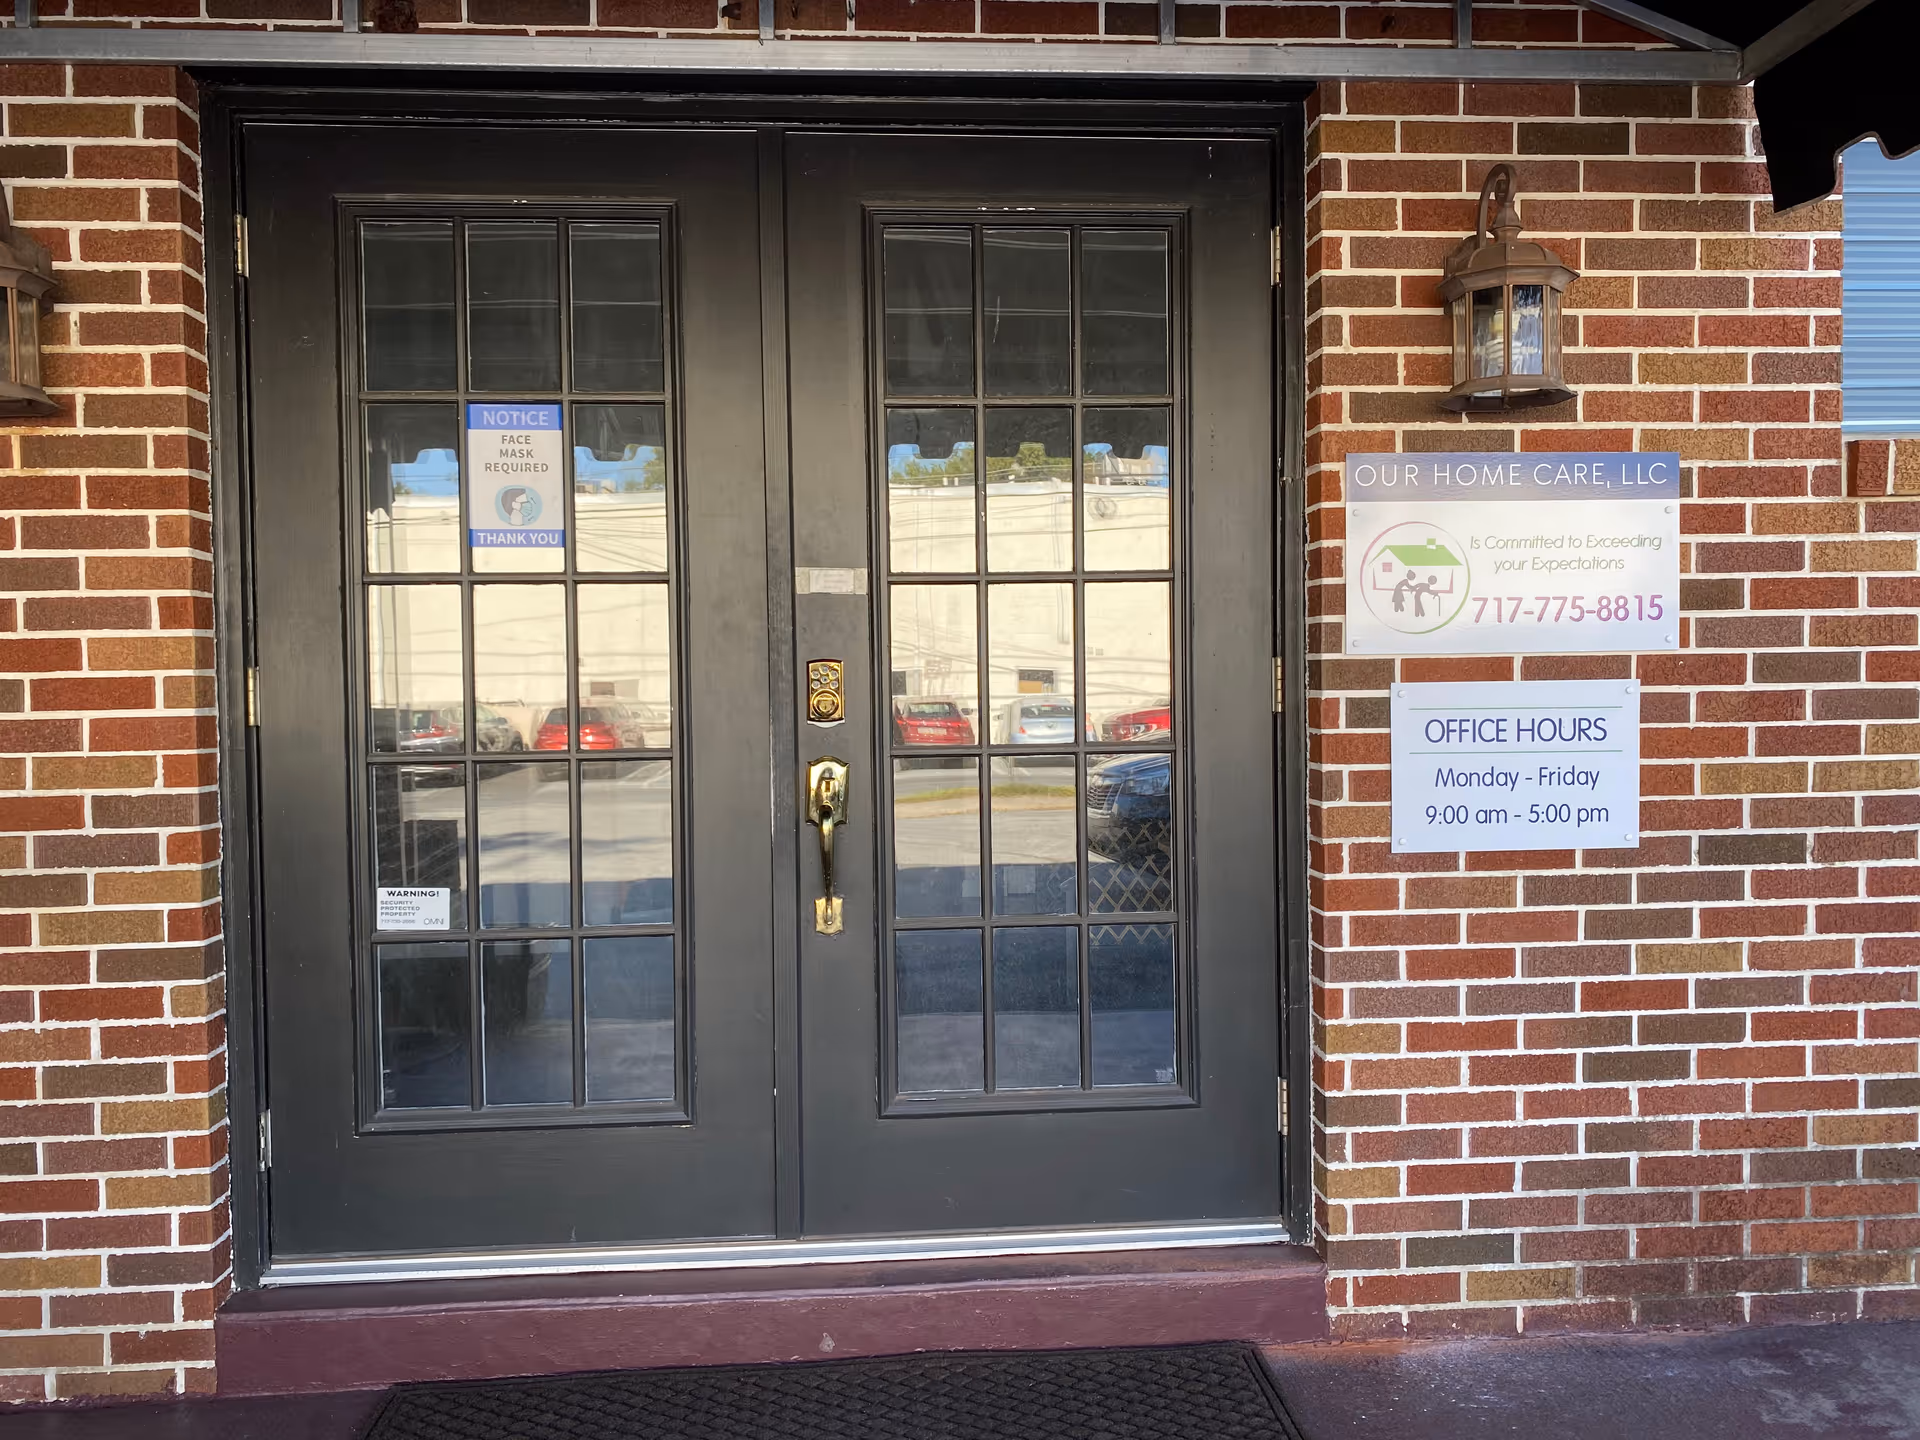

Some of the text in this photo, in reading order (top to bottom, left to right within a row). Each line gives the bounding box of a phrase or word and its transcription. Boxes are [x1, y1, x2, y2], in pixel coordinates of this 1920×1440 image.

[482, 410, 549, 426] NOTICE
[501, 434, 532, 445] FACE
[499, 448, 534, 459] MASK
[484, 462, 549, 474] REQUIRED
[1354, 462, 1668, 489] OUR HOME CARE, LLC
[477, 532, 558, 545] THANK YOU
[1470, 533, 1662, 551] Is Committed to Exceeding
[1494, 556, 1625, 574] your Expectations
[1471, 594, 1664, 623] 717-775-8815
[1425, 717, 1608, 743] OFFICE HOURS
[1435, 766, 1519, 791] Monday
[1538, 765, 1600, 790] Friday
[1425, 805, 1469, 825] 9:00
[1475, 808, 1508, 824] am
[1528, 803, 1571, 824] 5:00
[1577, 806, 1609, 828] pm
